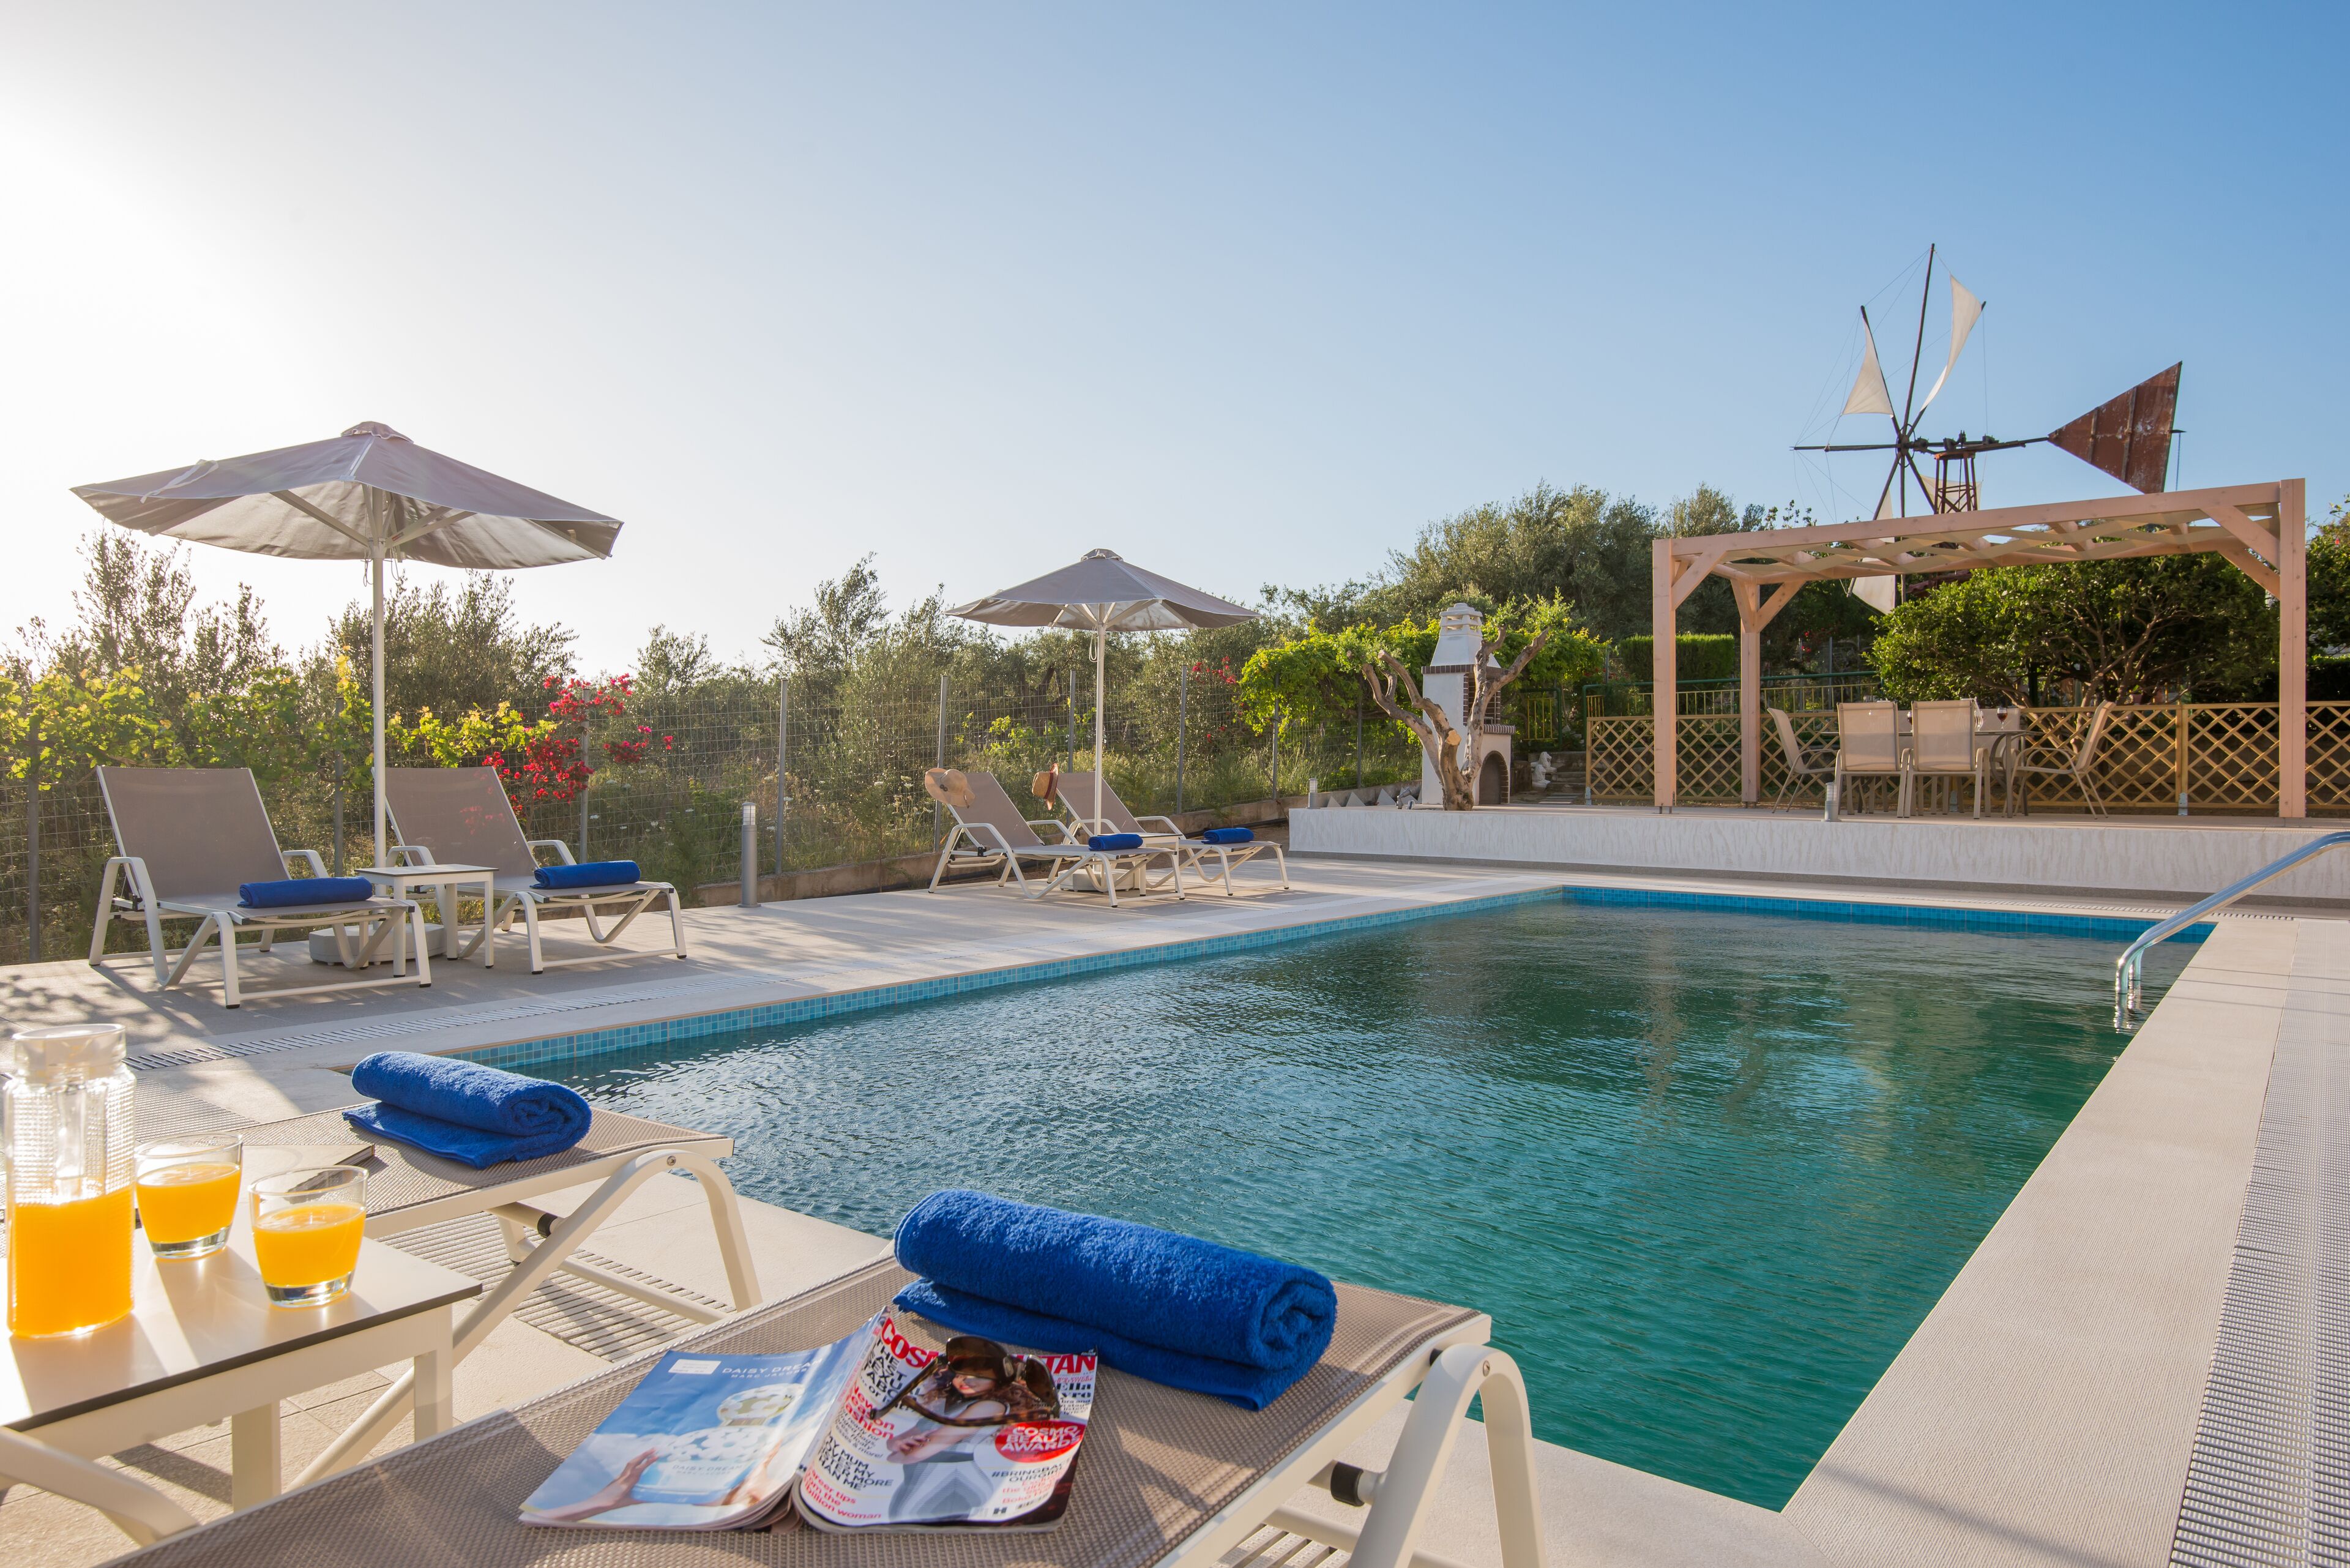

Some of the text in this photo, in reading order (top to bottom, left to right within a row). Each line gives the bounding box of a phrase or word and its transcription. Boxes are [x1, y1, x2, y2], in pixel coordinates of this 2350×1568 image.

[1006, 1429, 1081, 1443] BEAUTY
[1012, 1425, 1078, 1436] COSMO
[840, 1449, 870, 1470] MUM
[854, 1467, 876, 1478] MY
[852, 1474, 894, 1487] MORE
[824, 1492, 841, 1506] the
[836, 1491, 856, 1504] tips
[837, 1509, 882, 1519] woman
